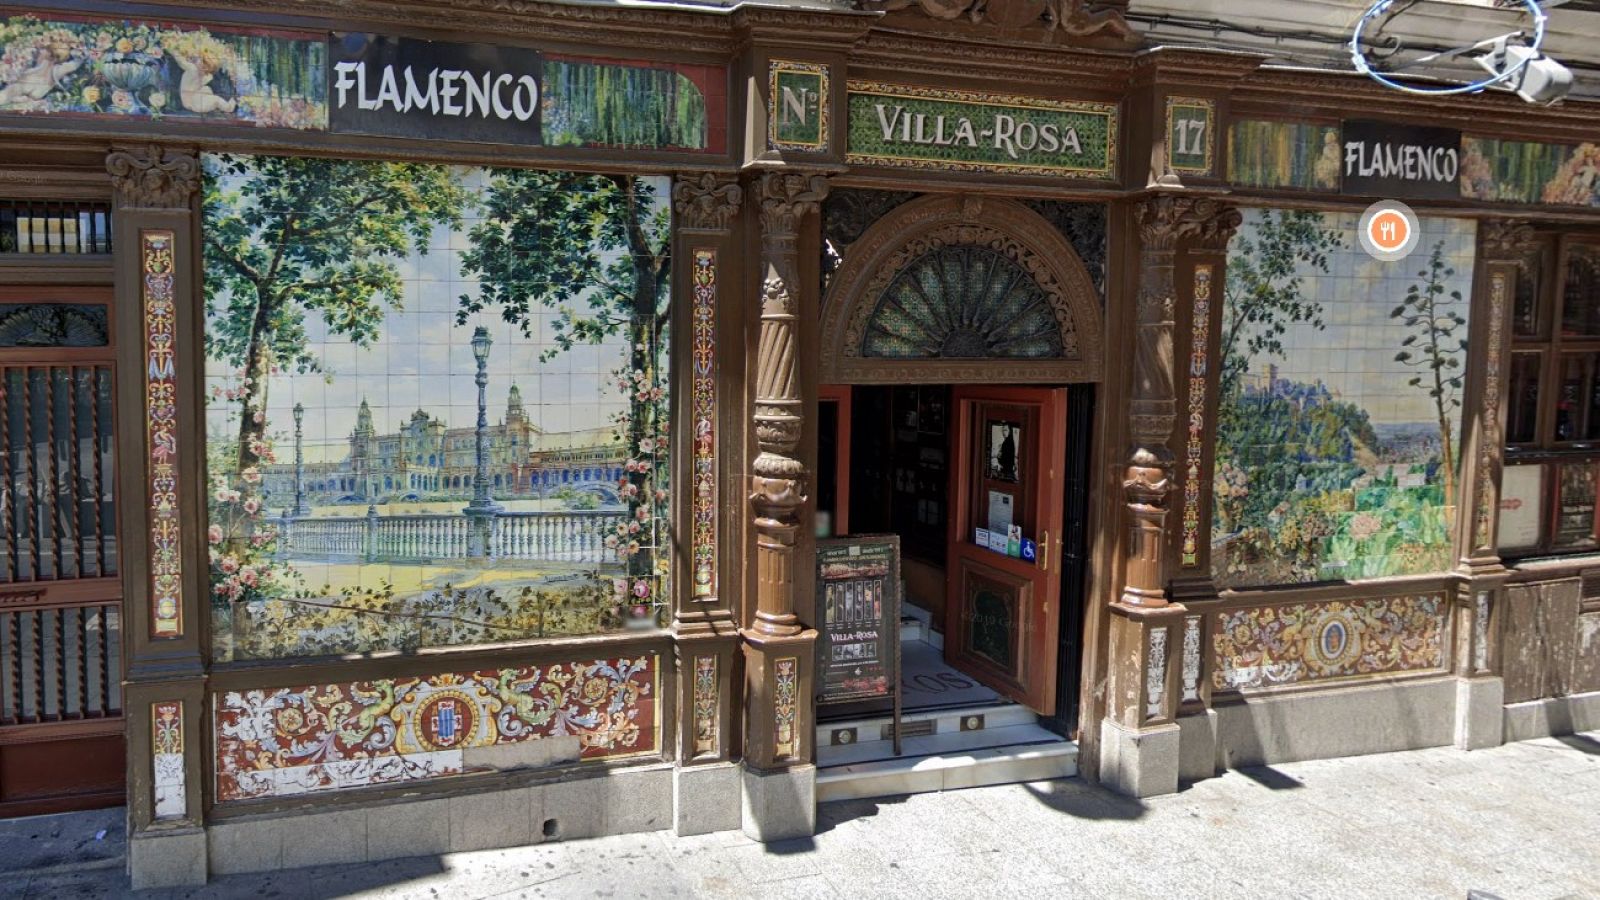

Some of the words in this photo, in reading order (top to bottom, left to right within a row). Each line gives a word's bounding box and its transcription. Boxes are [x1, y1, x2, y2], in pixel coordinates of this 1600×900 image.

[333, 61, 538, 122] FLAMENCO
[1175, 119, 1206, 155] 17
[1344, 141, 1458, 183] FLAMENCO
[830, 631, 878, 642] VILLA-ROSA
